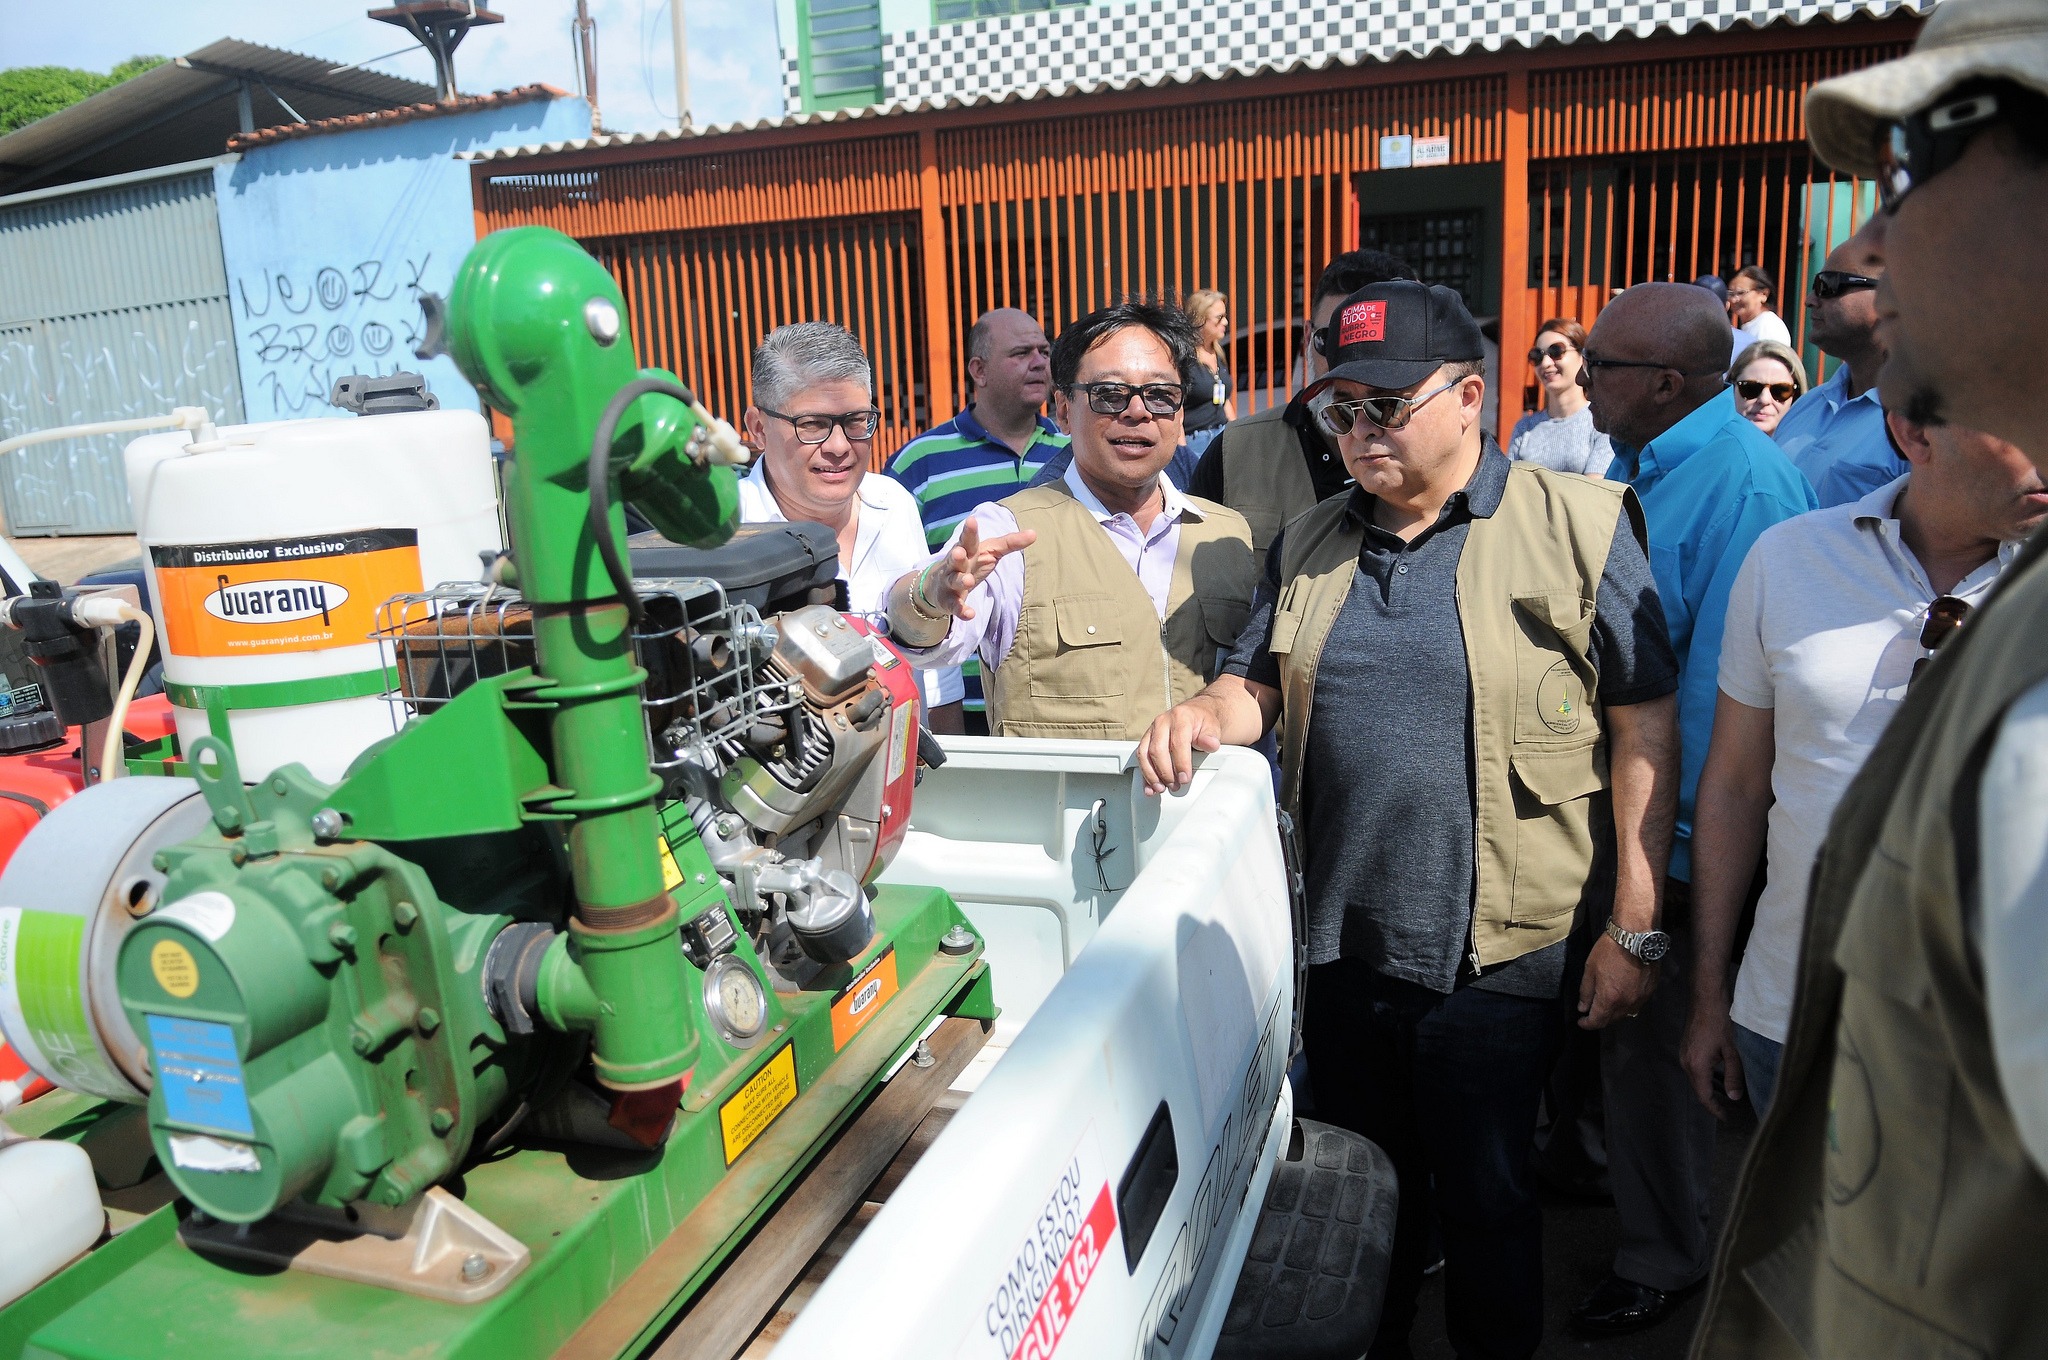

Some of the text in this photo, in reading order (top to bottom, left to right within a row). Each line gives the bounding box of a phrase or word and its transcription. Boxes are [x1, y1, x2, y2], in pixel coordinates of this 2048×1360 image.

[1342, 304, 1377, 318] ACIMA DE
[1342, 311, 1367, 327] TUDO
[1343, 329, 1377, 342] NEGRO
[193, 541, 345, 563] Distribuidor Exclusivo
[217, 575, 330, 627] Guarany
[227, 632, 334, 648] www.guaranyind.com.br
[743, 1077, 776, 1111] MAKE SURE ALL
[744, 1067, 772, 1099] CAUTION
[731, 1073, 789, 1135] CONNECTIONS WITH VEHICLE
[732, 1082, 790, 1144] ARE DISCONNECTED BEFORE
[743, 1099, 783, 1144] REMOVING MACHINE
[986, 1156, 1081, 1338] COMO ESTOU
[1062, 1222, 1100, 1307] 162
[1000, 1194, 1083, 1360] DIRIGINDO?
